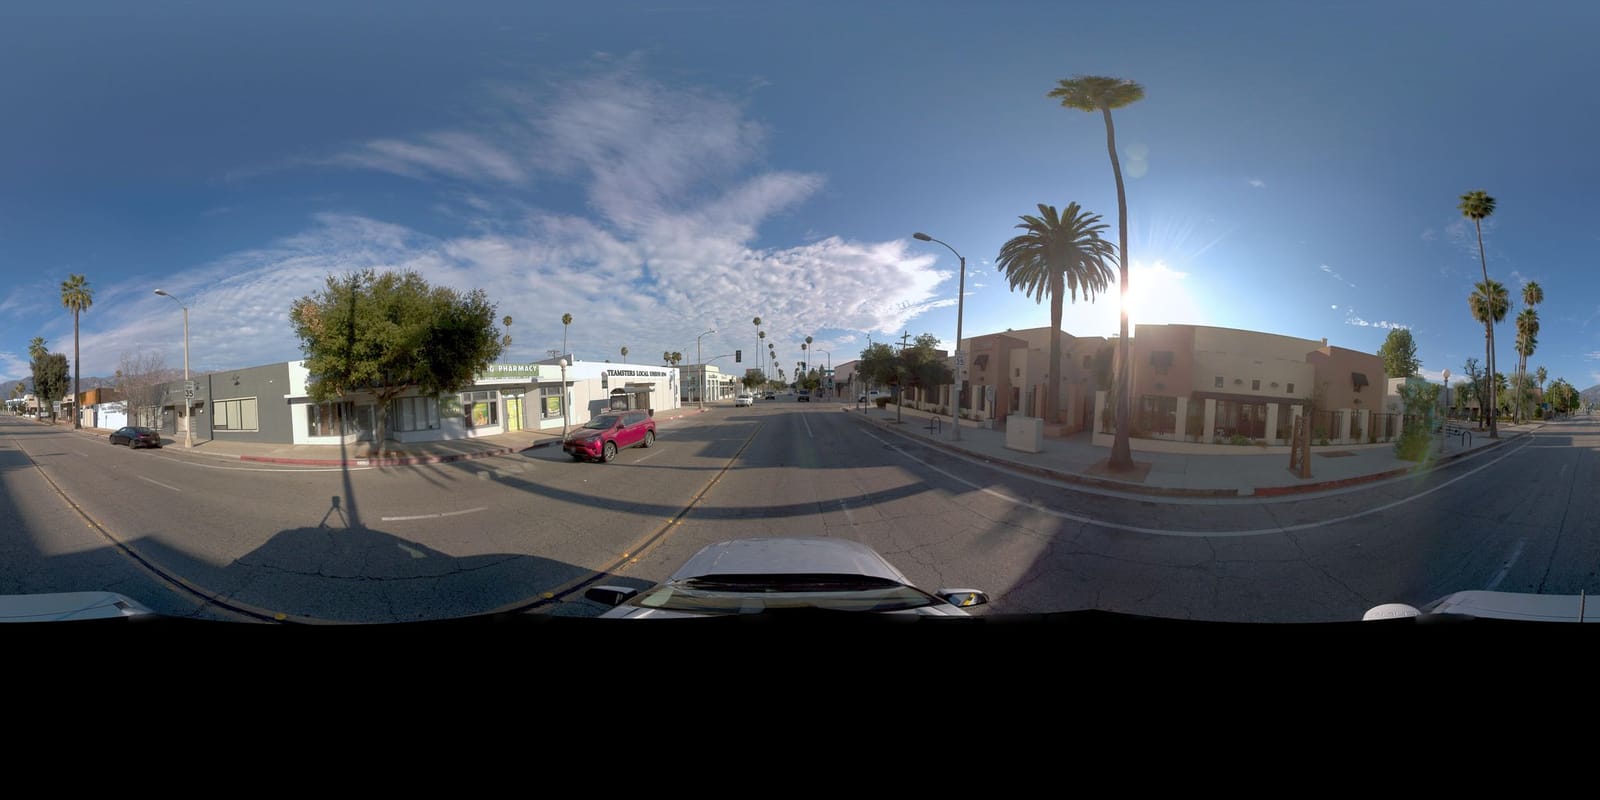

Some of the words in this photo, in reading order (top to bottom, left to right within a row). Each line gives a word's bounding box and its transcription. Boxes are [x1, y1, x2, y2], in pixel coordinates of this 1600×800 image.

[498, 364, 537, 372] PHARMACY
[607, 369, 636, 377] TEAMSTERS
[185, 389, 194, 398] 35
